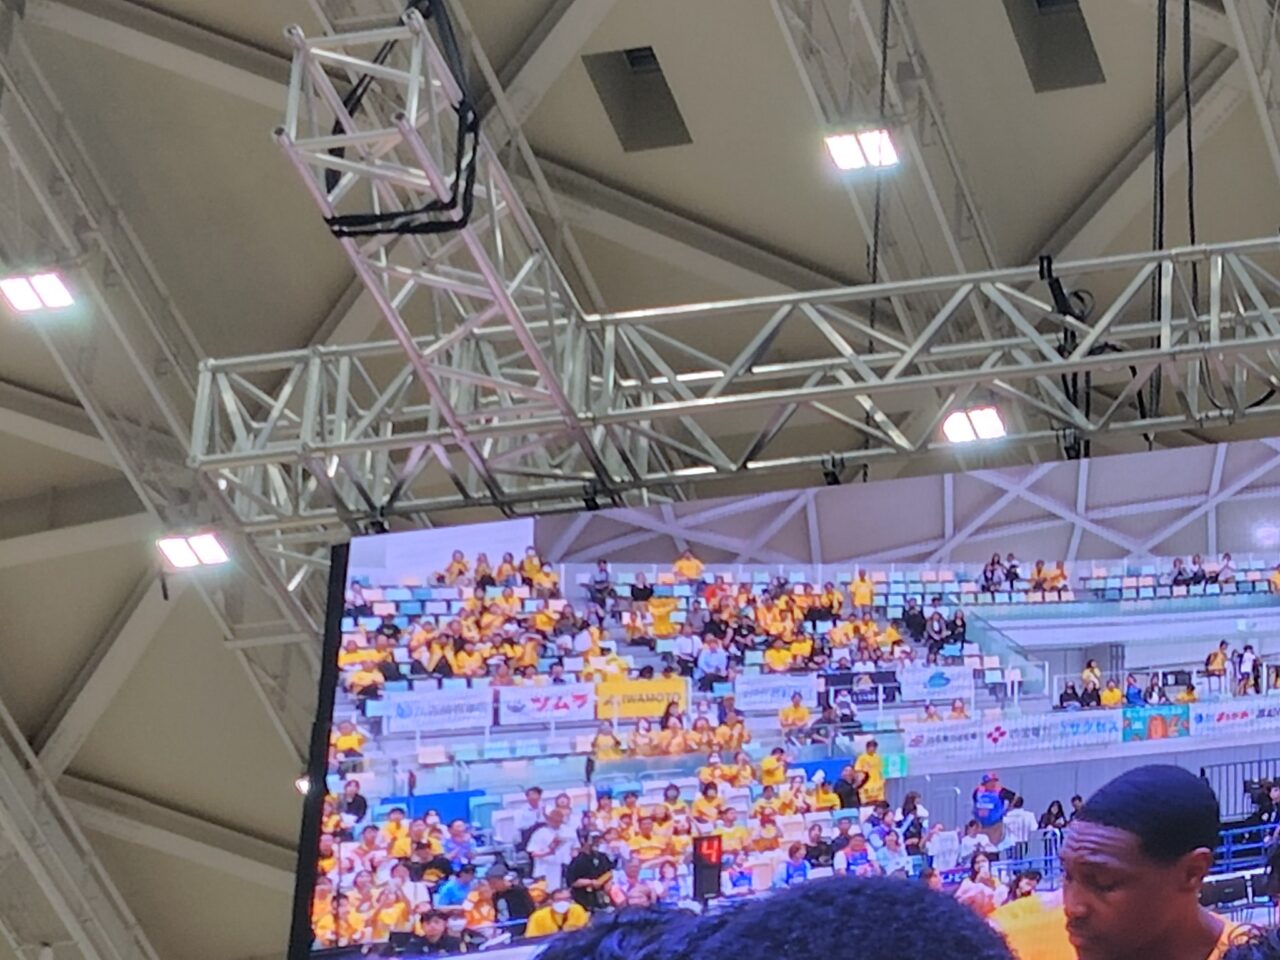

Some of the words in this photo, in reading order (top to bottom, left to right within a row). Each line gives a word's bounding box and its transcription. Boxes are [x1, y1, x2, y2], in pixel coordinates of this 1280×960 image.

[530, 693, 589, 712] ツムラ
[701, 837, 720, 864] 4
